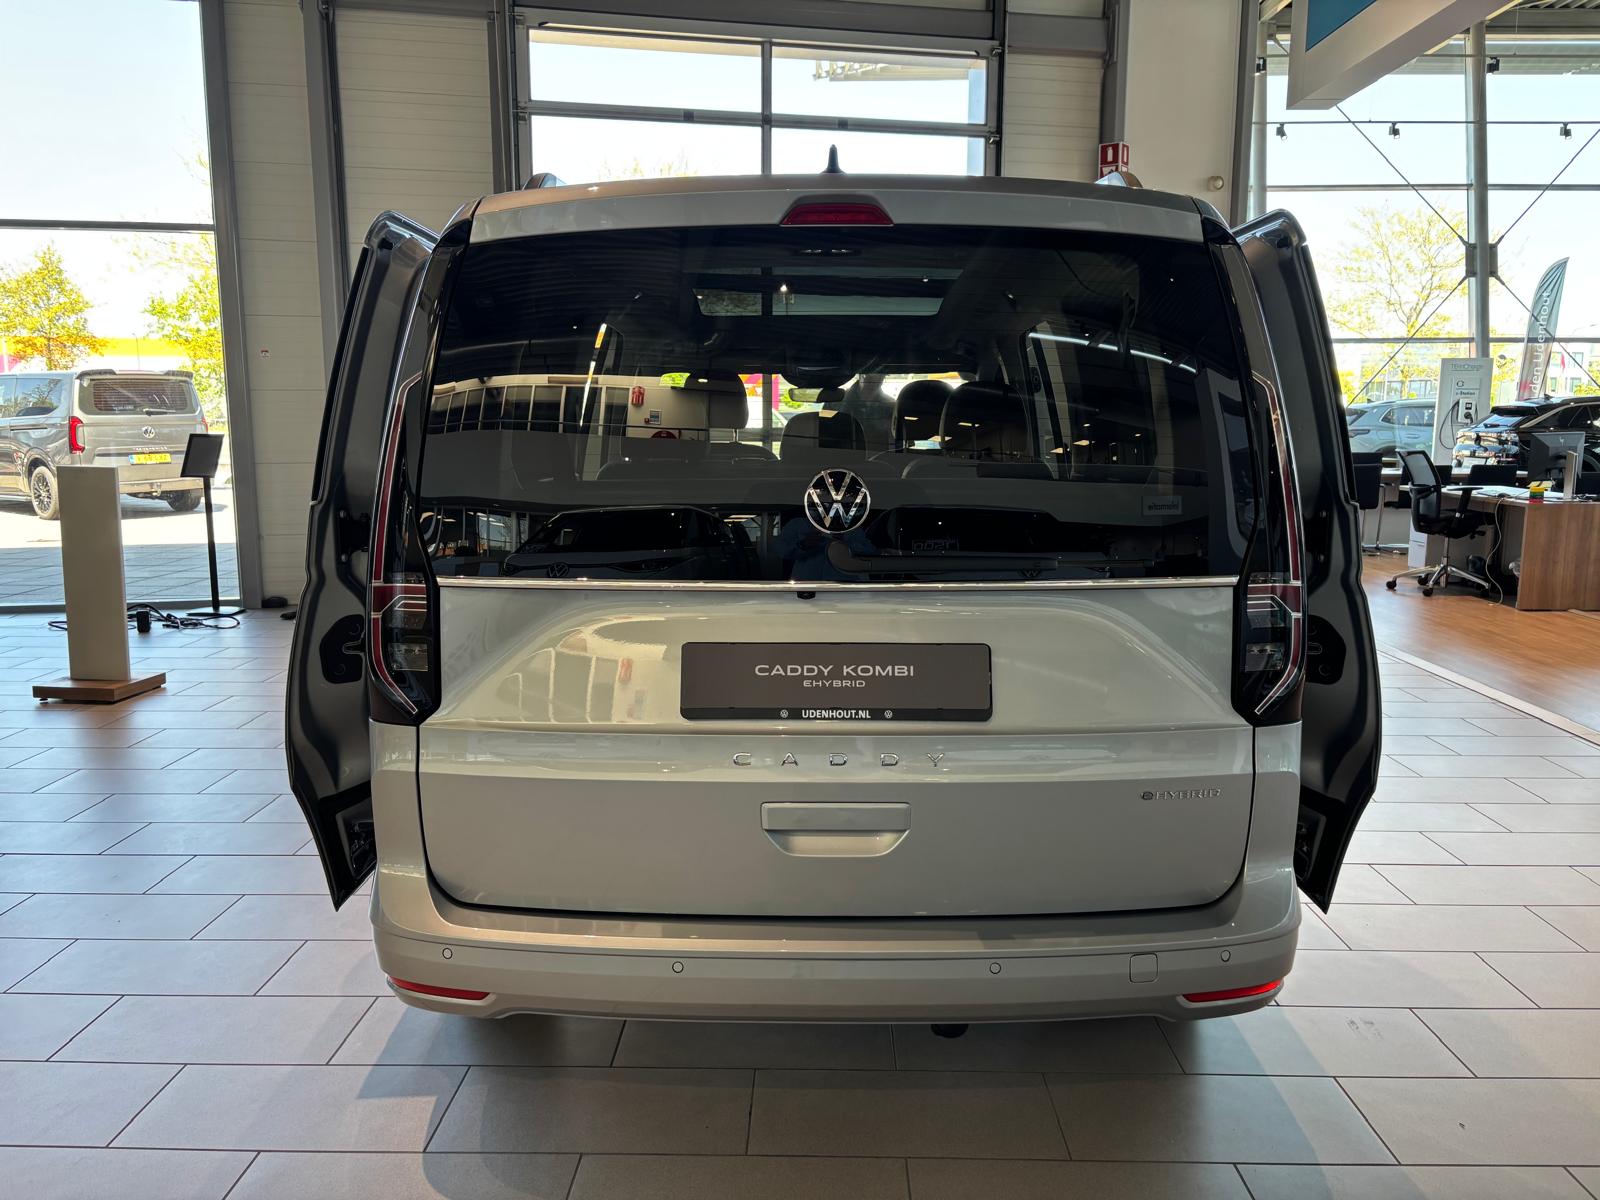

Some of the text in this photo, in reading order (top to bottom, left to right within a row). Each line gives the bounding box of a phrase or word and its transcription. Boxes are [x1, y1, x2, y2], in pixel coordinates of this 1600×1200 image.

[1529, 290, 1551, 393] den Udenhout
[754, 664, 914, 677] CADDY KOMBI
[803, 679, 866, 688] EHYBRID
[801, 709, 871, 719] UDENHOUT.NL
